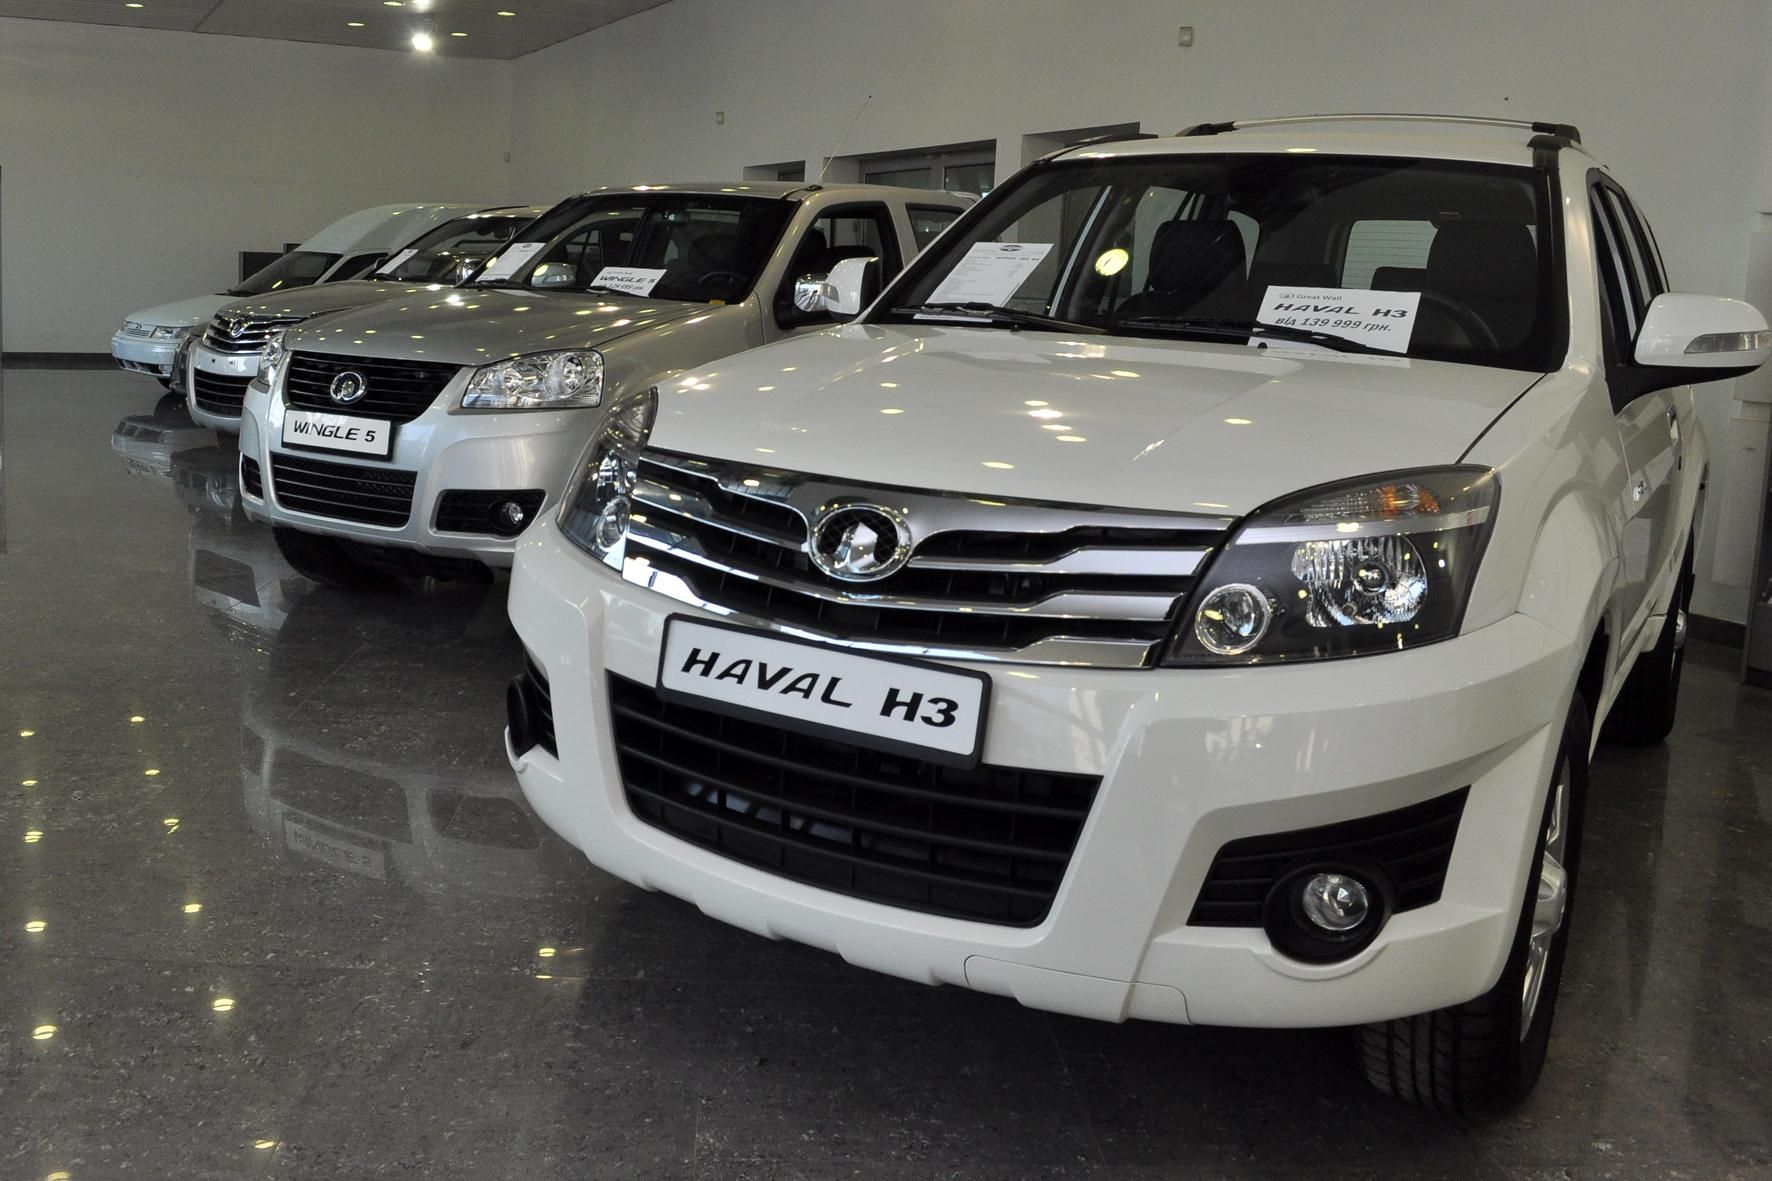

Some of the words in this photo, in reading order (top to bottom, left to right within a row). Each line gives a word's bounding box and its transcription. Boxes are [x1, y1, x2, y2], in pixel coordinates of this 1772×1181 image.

[600, 275, 648, 283] WINGLE
[1273, 303, 1360, 315] HAVAL
[1372, 308, 1408, 319] H3
[1300, 317, 1330, 327] 139
[1331, 319, 1362, 329] 999
[1362, 323, 1391, 332] грн.
[293, 420, 361, 441] WINGLE
[364, 430, 377, 443] 5
[681, 647, 853, 708] HAVAL
[879, 687, 960, 728] H3
